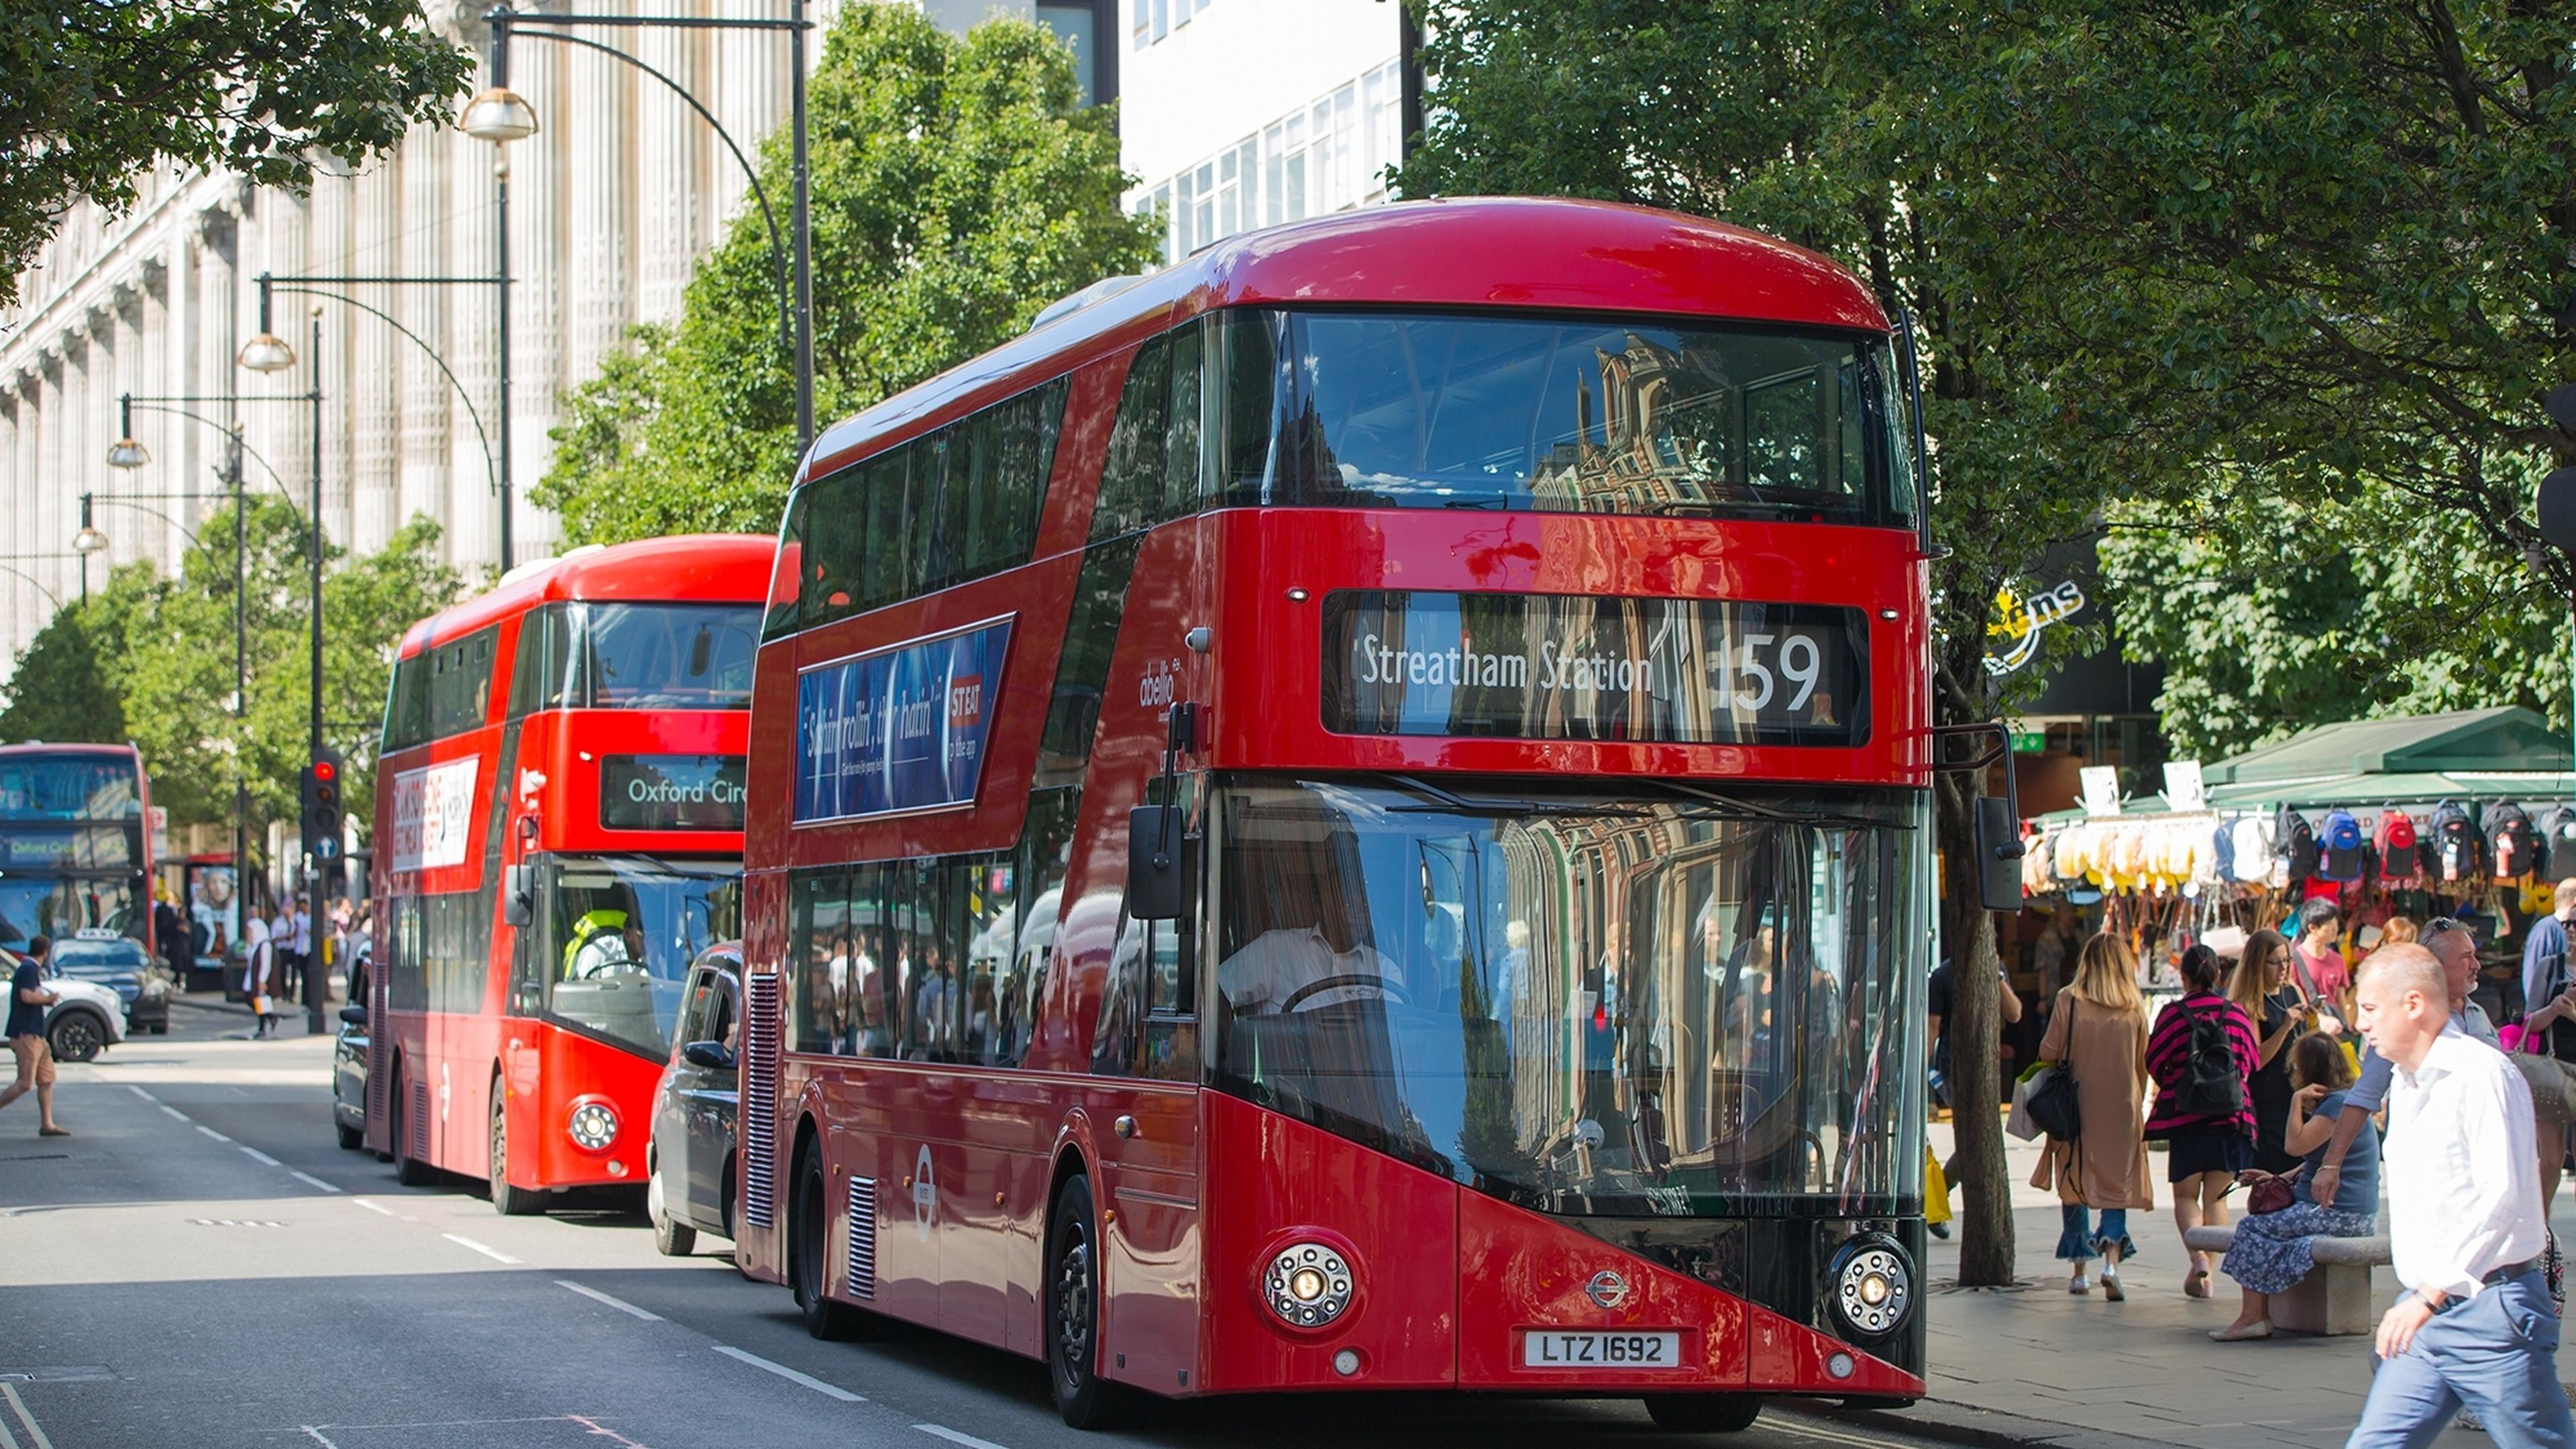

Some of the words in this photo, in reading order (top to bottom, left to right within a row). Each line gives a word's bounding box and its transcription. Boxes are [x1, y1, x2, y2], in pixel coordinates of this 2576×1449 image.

[1140, 660, 1174, 707] abellio
[1362, 633, 1526, 688] Streatham
[1540, 640, 1653, 692] Station
[1719, 633, 1821, 711] 159
[629, 778, 704, 804] Oxford
[1542, 1336, 1595, 1361] LTZ
[1603, 1336, 1662, 1362] 1692
